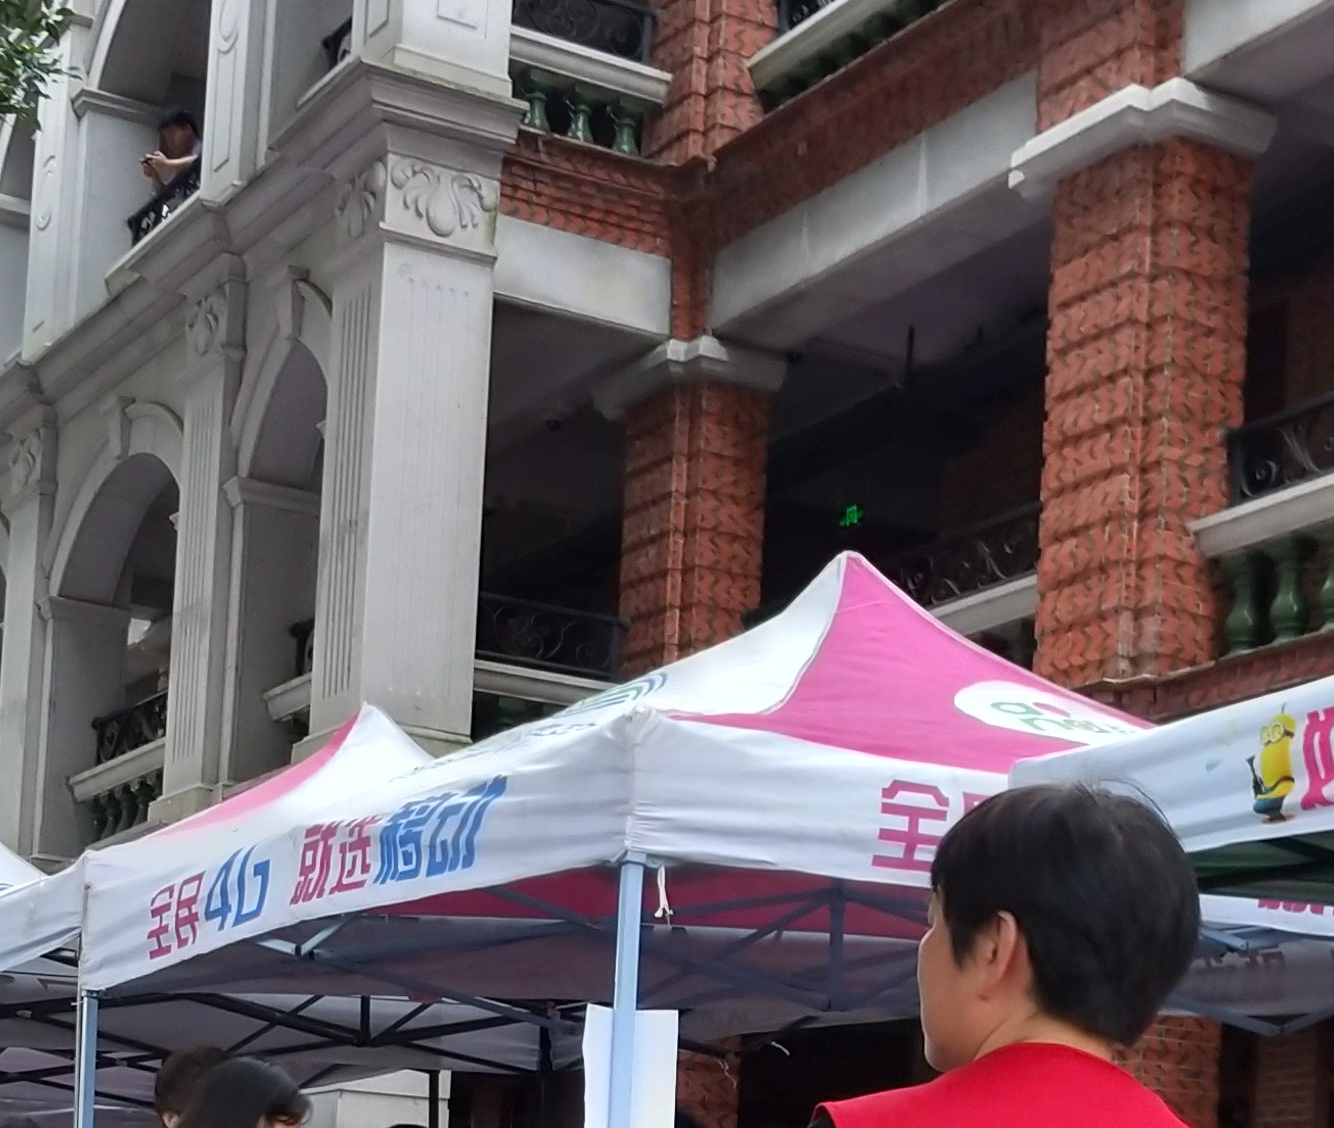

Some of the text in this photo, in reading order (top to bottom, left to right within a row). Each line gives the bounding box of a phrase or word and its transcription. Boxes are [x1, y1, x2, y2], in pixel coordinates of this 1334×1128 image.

[146, 774, 510, 960] 全民4G 就选移动
